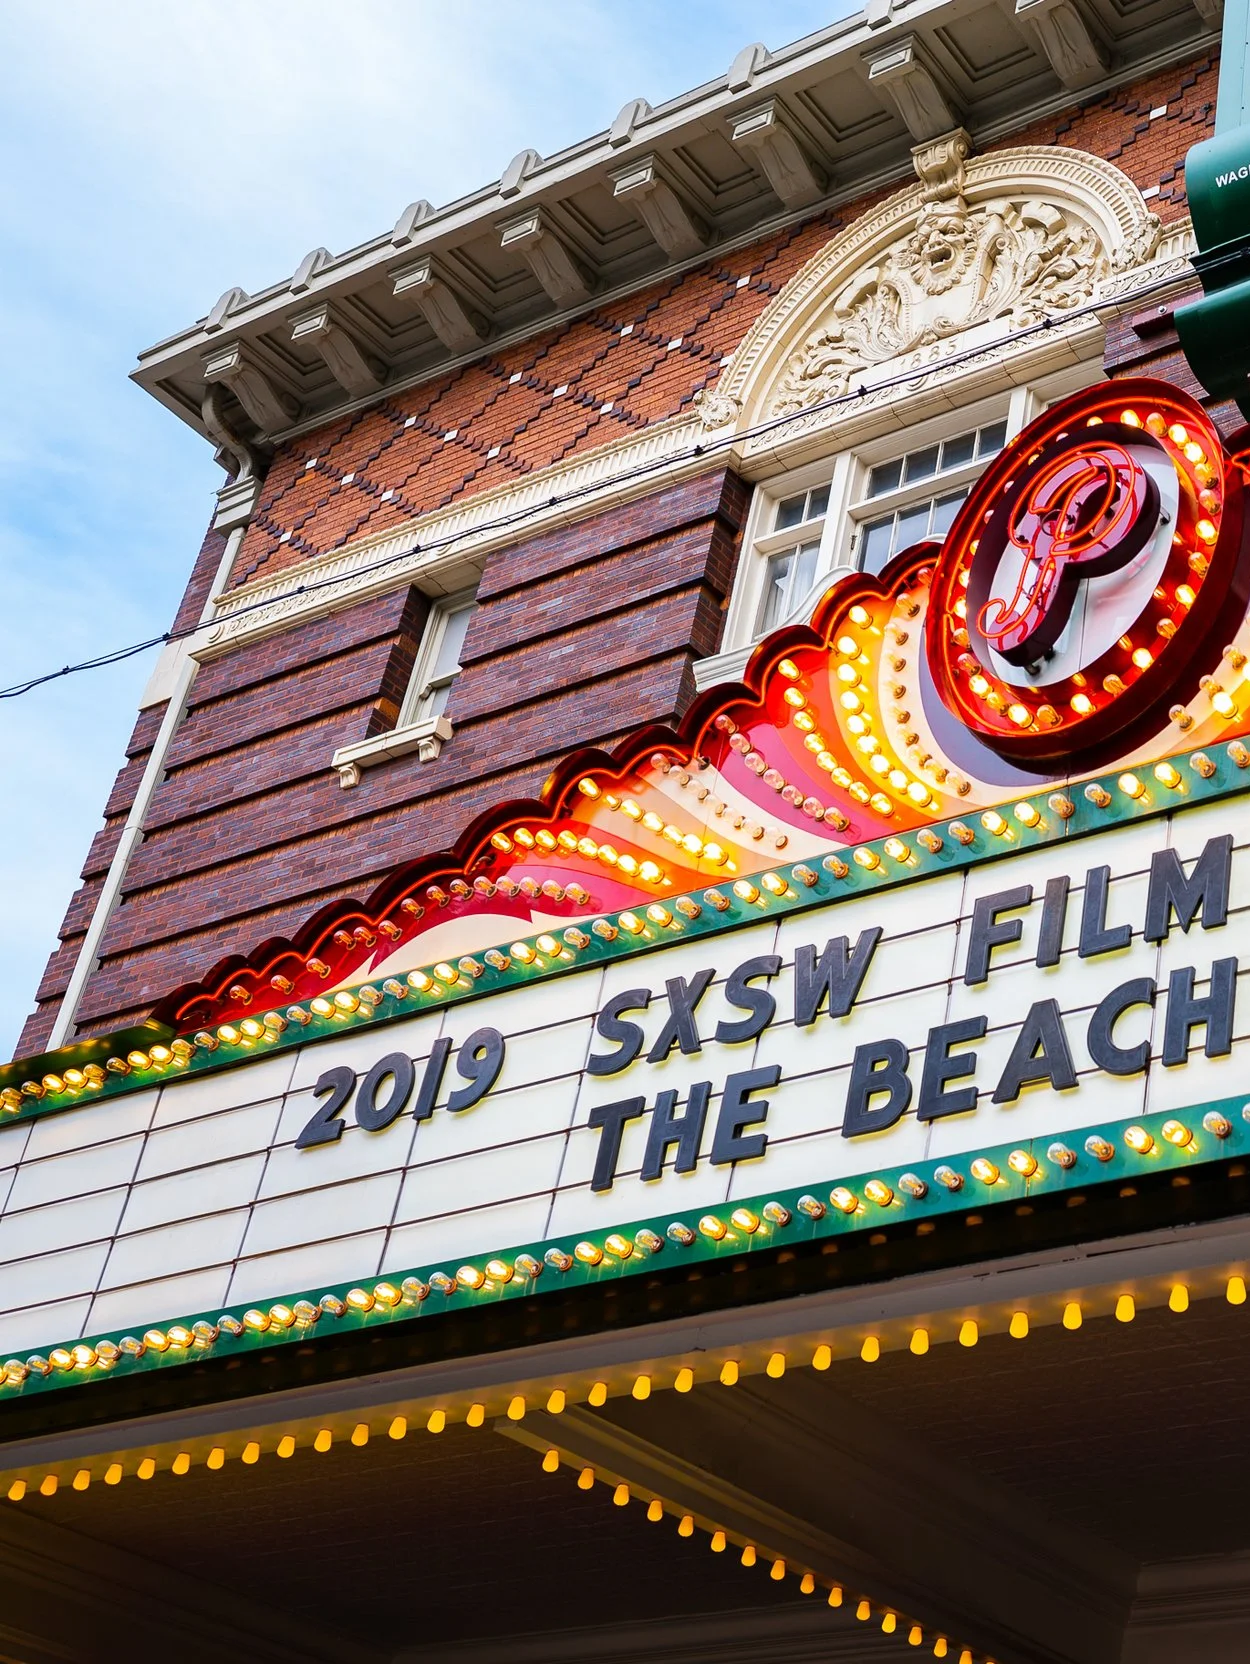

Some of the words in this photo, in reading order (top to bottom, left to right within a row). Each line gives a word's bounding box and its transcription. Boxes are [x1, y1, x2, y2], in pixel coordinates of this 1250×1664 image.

[900, 338, 957, 371] 1885
[297, 1027, 505, 1149] 2019
[585, 925, 882, 1076] SXSW
[964, 833, 1234, 986] FILM
[587, 1063, 782, 1192] THE
[842, 956, 1239, 1138] BEACH
